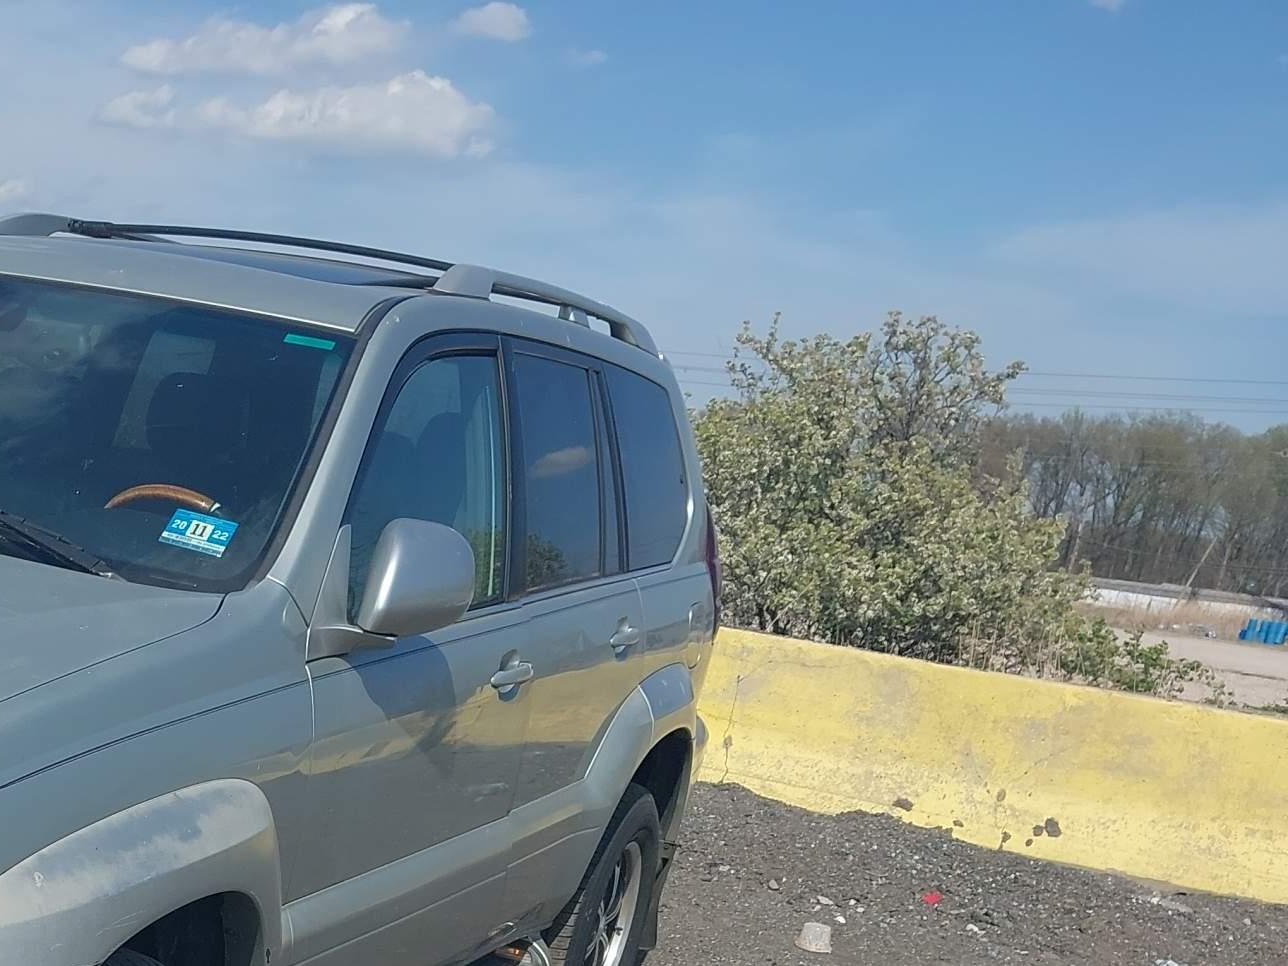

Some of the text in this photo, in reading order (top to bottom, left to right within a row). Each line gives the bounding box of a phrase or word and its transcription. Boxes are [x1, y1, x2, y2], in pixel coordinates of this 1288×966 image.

[171, 519, 229, 541] 20 11 22
